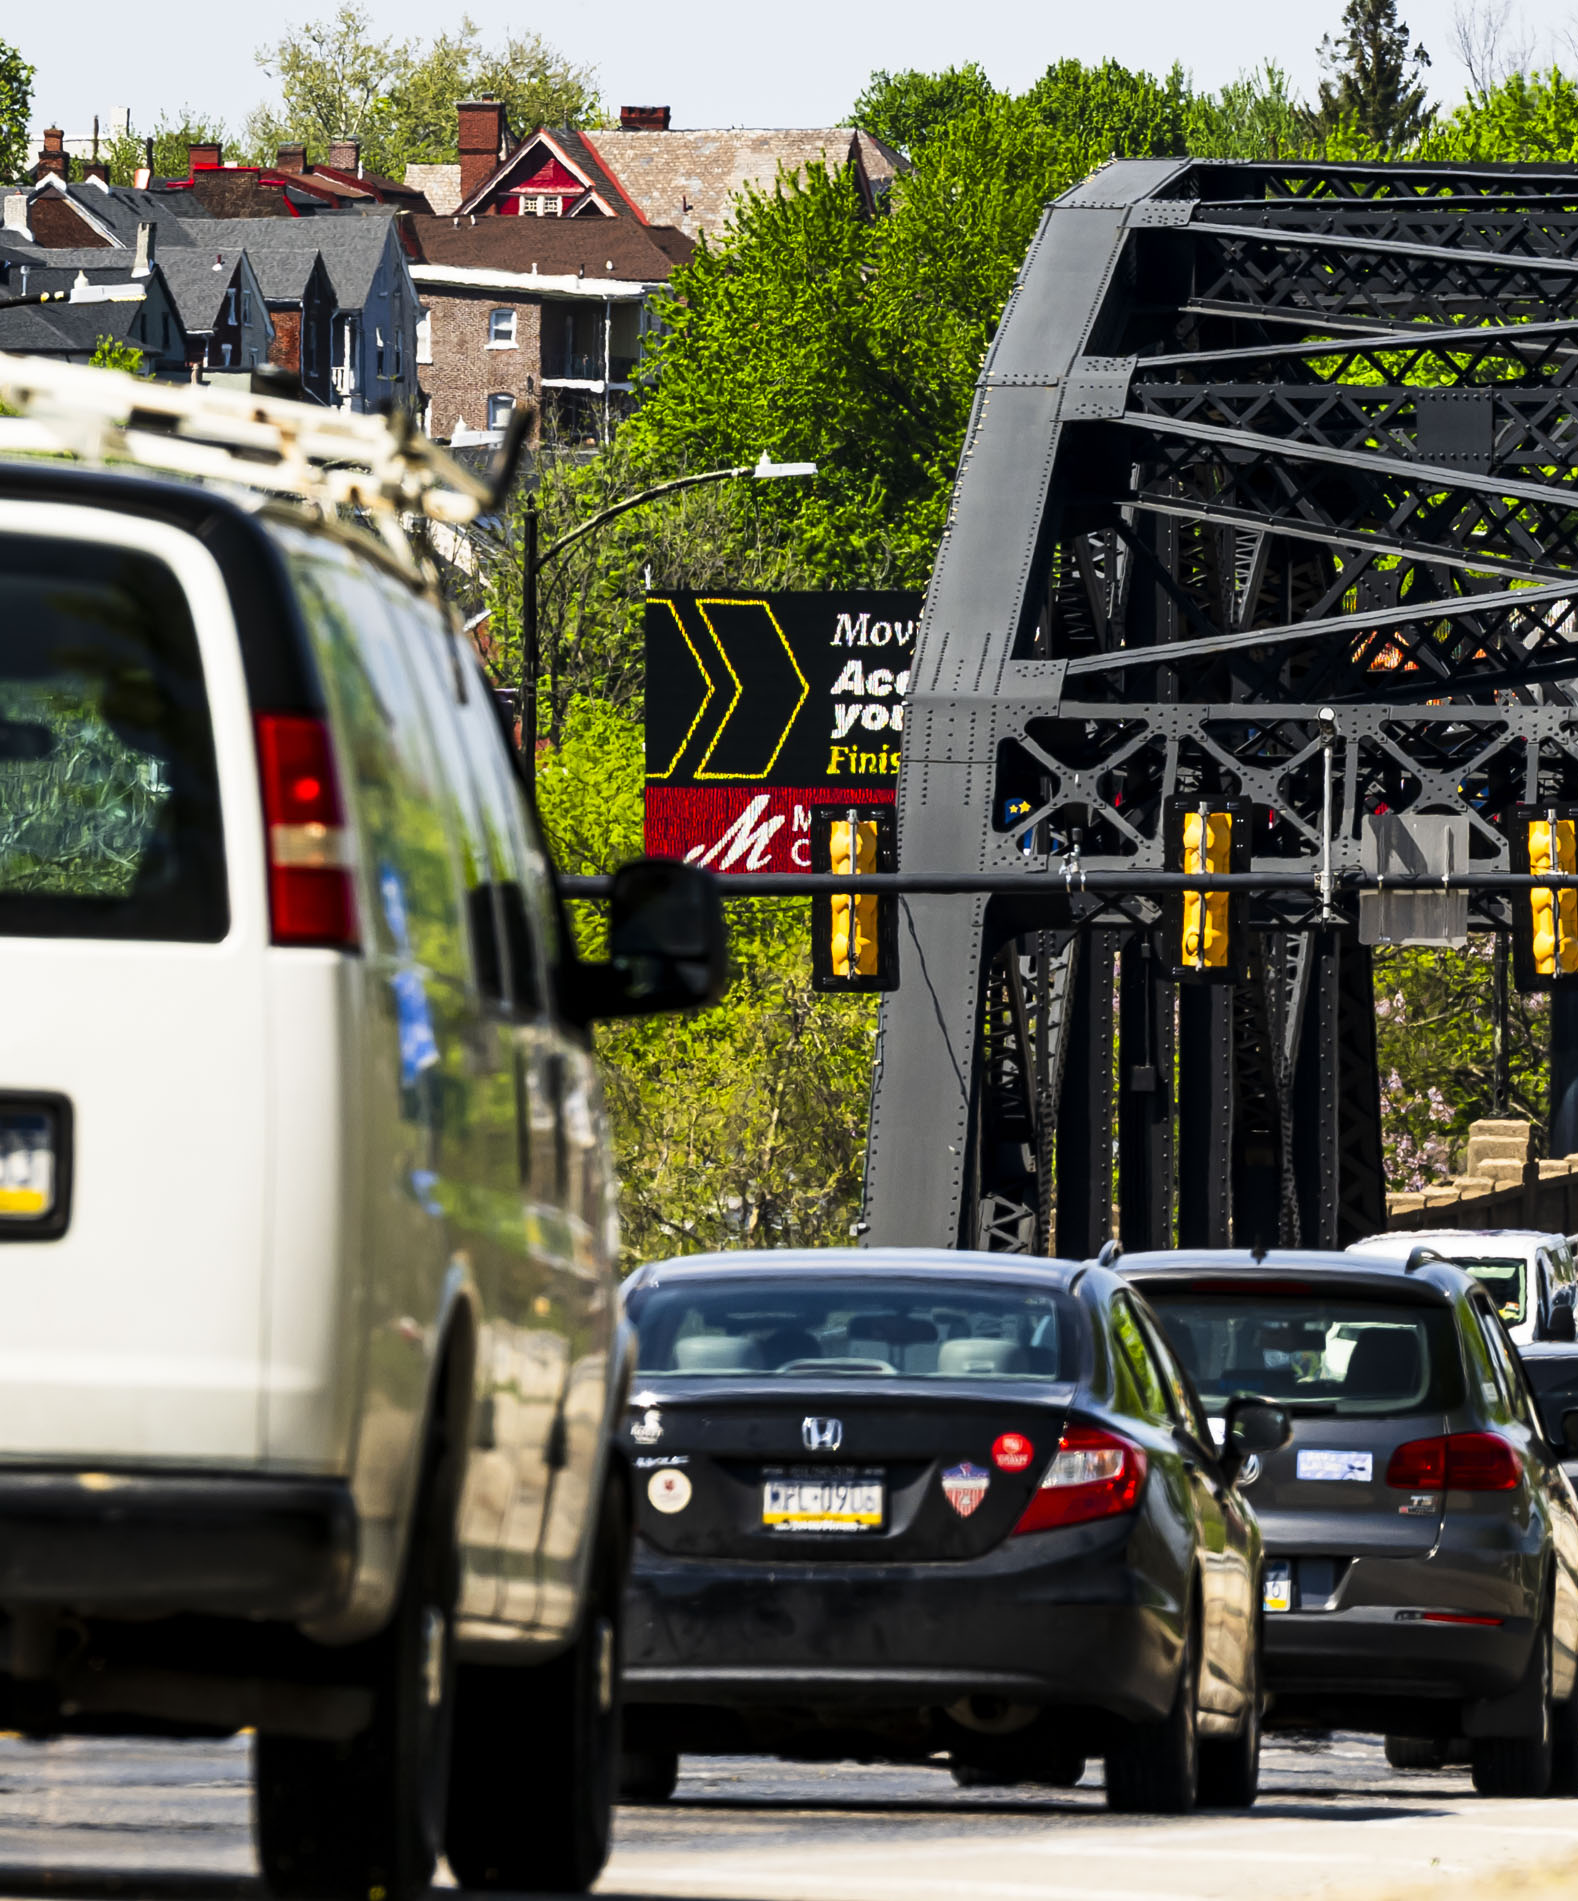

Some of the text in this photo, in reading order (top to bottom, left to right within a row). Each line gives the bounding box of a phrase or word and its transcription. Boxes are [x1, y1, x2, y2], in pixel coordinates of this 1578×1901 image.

[830, 659, 911, 697] Acc
[830, 703, 904, 739] you
[826, 744, 902, 775] Finis
